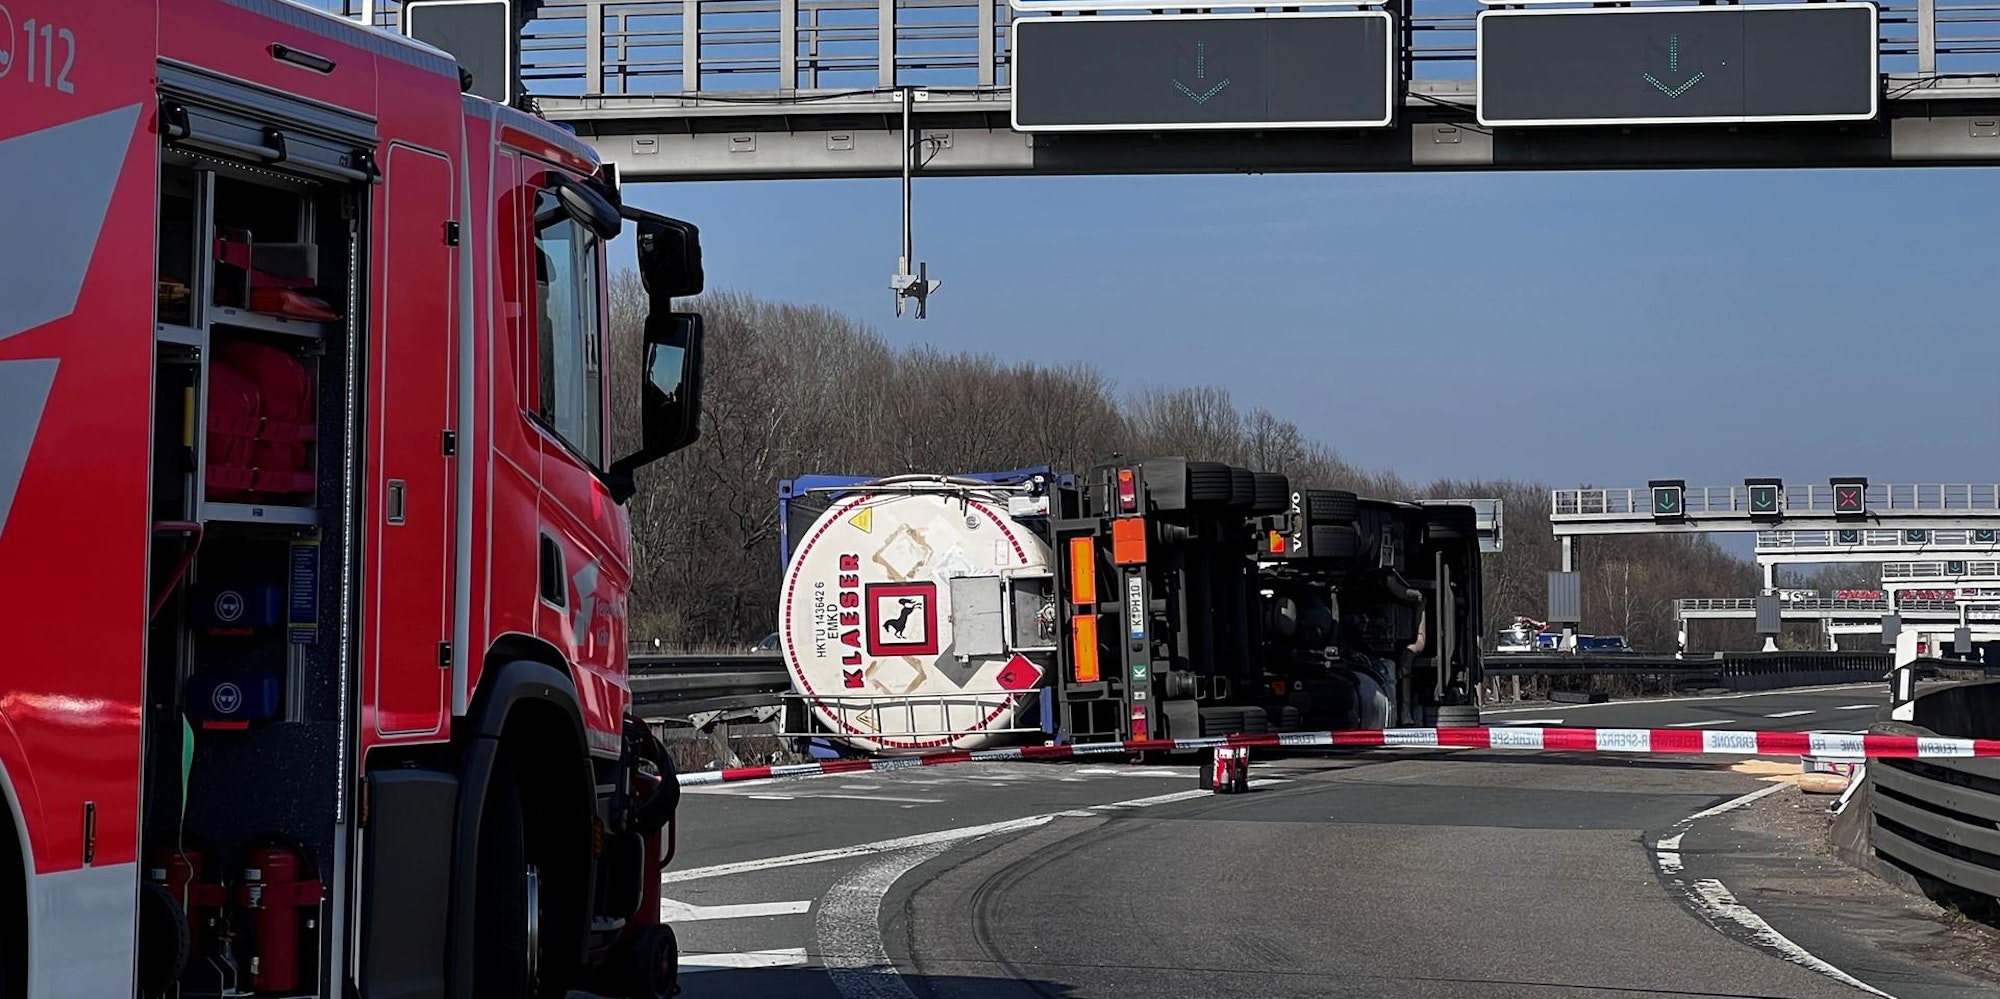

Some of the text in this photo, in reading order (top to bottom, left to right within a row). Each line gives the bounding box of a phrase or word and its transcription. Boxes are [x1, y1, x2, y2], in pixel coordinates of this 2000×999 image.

[23, 18, 75, 94] 112
[1291, 491, 1302, 553] VVO
[814, 581, 826, 658] HKTU 143642 6
[827, 603, 839, 639] EMKD
[839, 554, 865, 688] KLAESER
[1133, 667, 1146, 678] K
